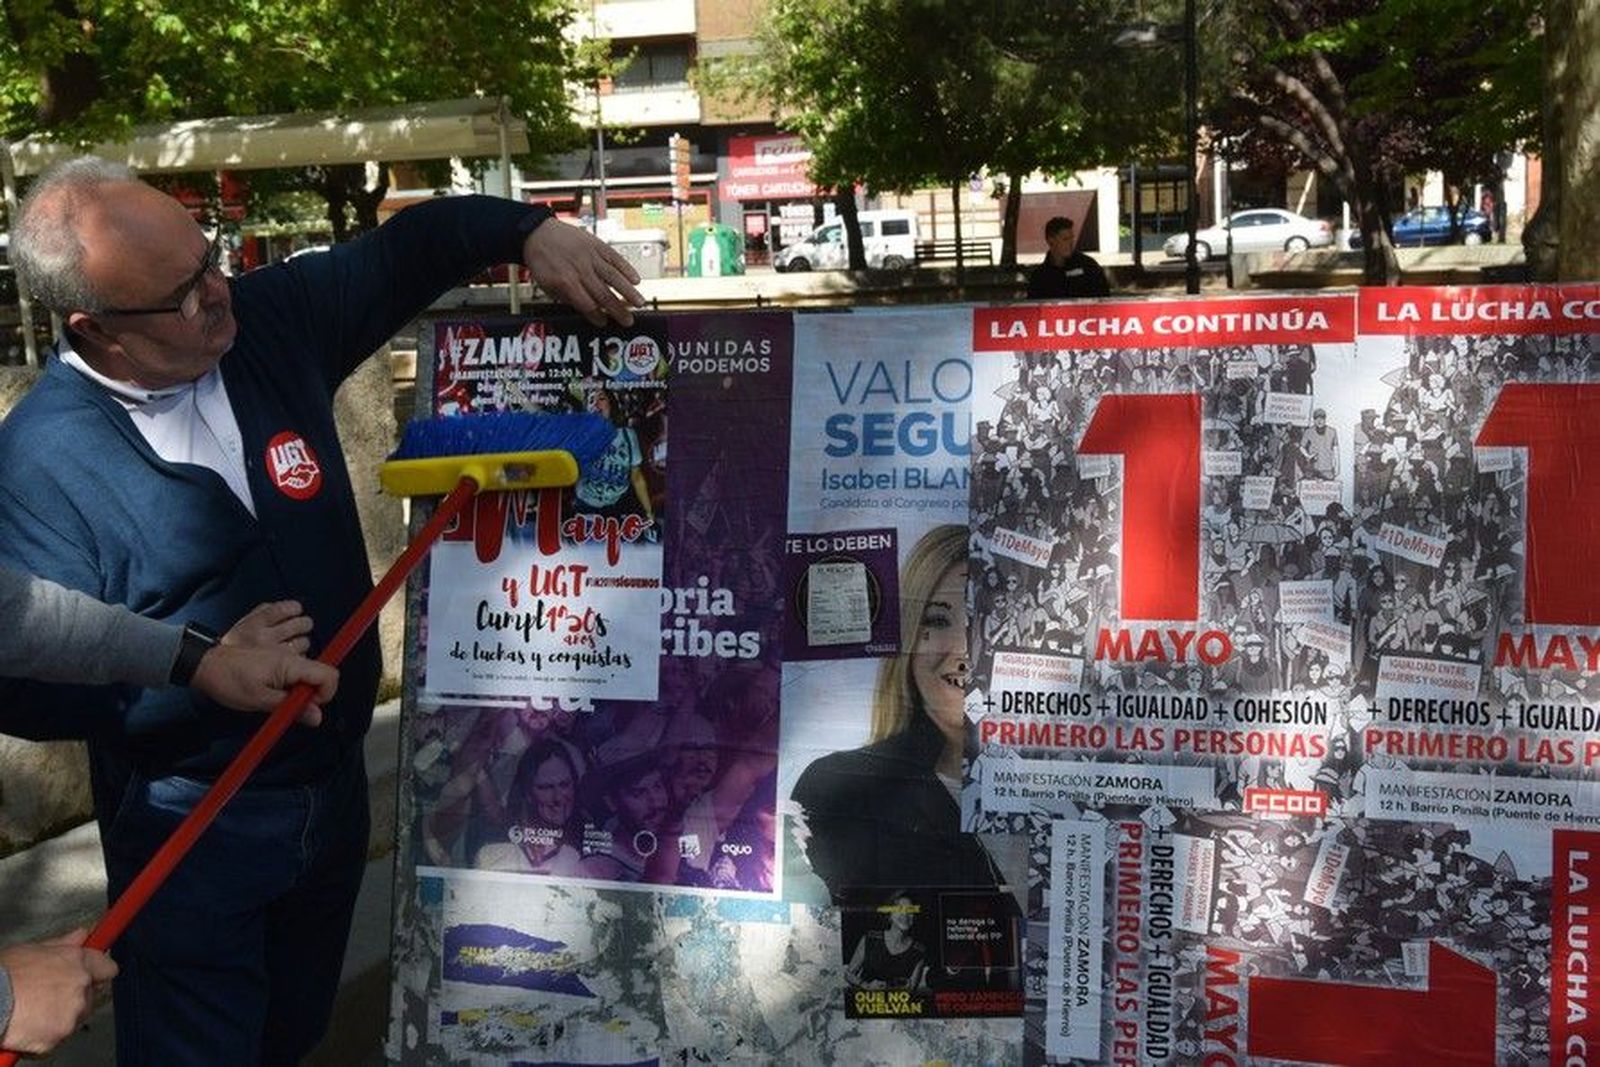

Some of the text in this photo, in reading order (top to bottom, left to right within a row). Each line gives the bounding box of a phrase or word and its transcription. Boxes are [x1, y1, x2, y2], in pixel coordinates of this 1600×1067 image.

[990, 308, 1329, 339] LA LUCHA CONTINÚA
[1377, 302, 1421, 321] LA
[1431, 301, 1551, 320] LUCHA
[679, 339, 772, 356] UNIDAS
[679, 358, 771, 374] PODEMOS
[825, 358, 972, 405] VALO
[824, 412, 972, 458] SEGU
[822, 467, 897, 490] Isabel
[807, 539, 828, 553] LO
[833, 534, 892, 551] DEBEN
[992, 532, 1051, 561] #1DeMayo
[1377, 527, 1444, 558] #1DeMayo
[502, 577, 520, 607] y
[530, 565, 588, 598] UGT
[450, 642, 467, 661] de
[531, 650, 542, 671] y
[1094, 627, 1235, 666] MAYO
[1389, 658, 1436, 674] IGUALDAD
[1002, 690, 1092, 717] DERECHOS
[1116, 694, 1208, 721] IGUALDAD
[1233, 697, 1327, 726] COHESIÓN
[1388, 697, 1491, 726] DERECHOS
[980, 720, 1327, 759] PRIMERO LAS PERSONAS
[1364, 728, 1509, 761] PRIMERO
[1518, 738, 1575, 765] LAS
[993, 771, 1164, 791] MANIFESTACIÓN ZAMORA
[993, 788, 1007, 797] 12
[1021, 788, 1055, 800] Barrio
[1057, 789, 1090, 801] Pinilla
[1138, 795, 1153, 805] de
[1379, 783, 1573, 807] MANIFESTACIÓN ZAMORA
[1251, 793, 1322, 814] CCOO
[1379, 800, 1395, 811] 12
[1396, 801, 1406, 812] h.
[1410, 801, 1449, 814] Barrio
[1451, 804, 1490, 818] Pinilla
[1492, 805, 1541, 821] (Puente
[1544, 811, 1560, 822] de
[1066, 833, 1077, 846] 12
[1064, 861, 1076, 897] Barrio
[1116, 821, 1144, 953] PRIMERO
[1312, 844, 1342, 906] #1DeMayo
[1568, 850, 1590, 893] LA
[1148, 845, 1175, 940] DERECHOS
[1063, 899, 1075, 934] Pinilla
[1076, 833, 1092, 1007] MANIFESTACIÓN ZAMORA
[1566, 905, 1590, 1024] LUCHA
[854, 991, 910, 1004] QUE NO
[1061, 981, 1072, 996] de
[1113, 961, 1140, 1014] LAS
[855, 1002, 923, 1014] VUELVAN
[1146, 964, 1172, 1059] IGUALDAD
